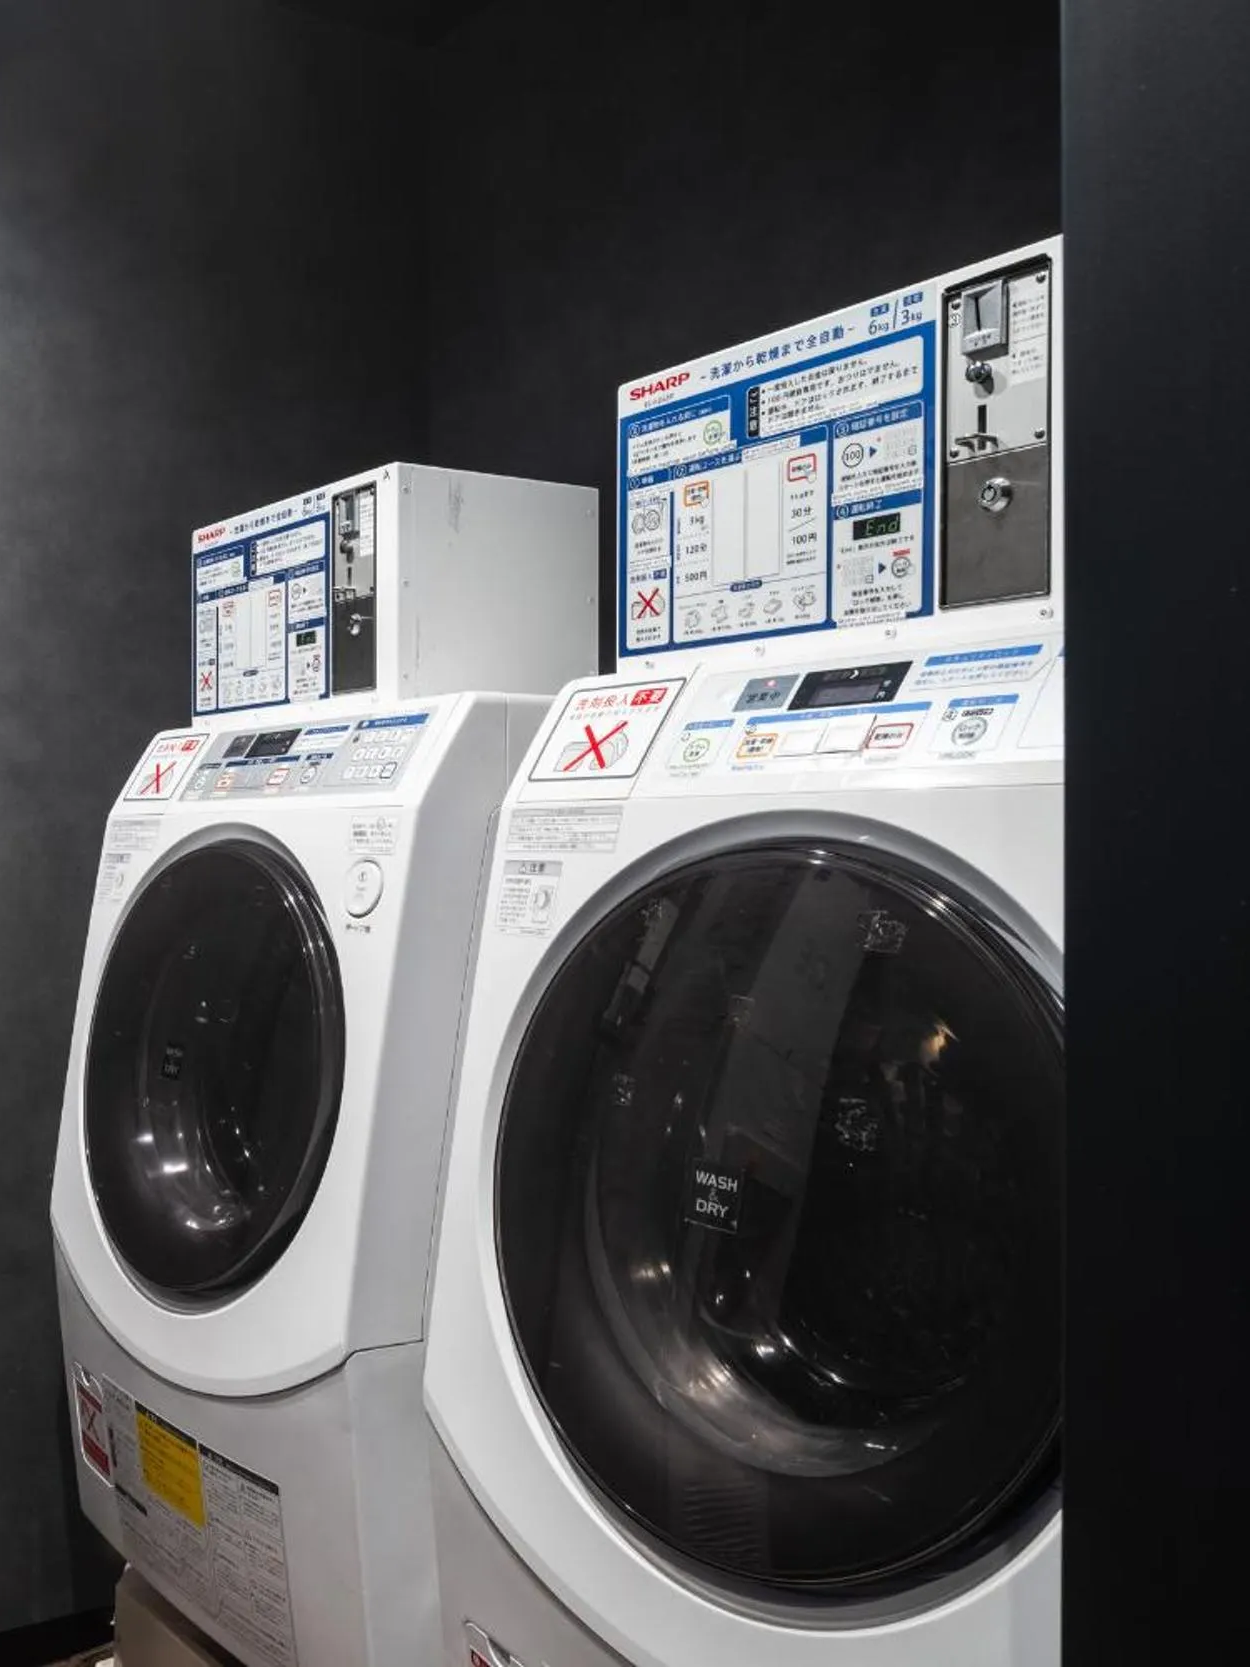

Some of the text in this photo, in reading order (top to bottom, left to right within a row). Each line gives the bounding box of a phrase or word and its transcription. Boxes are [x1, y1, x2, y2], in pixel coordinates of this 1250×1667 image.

[629, 372, 691, 401] SHARP
[866, 513, 899, 537] End
[695, 1169, 738, 1192] WASH
[695, 1198, 729, 1218] DRY
